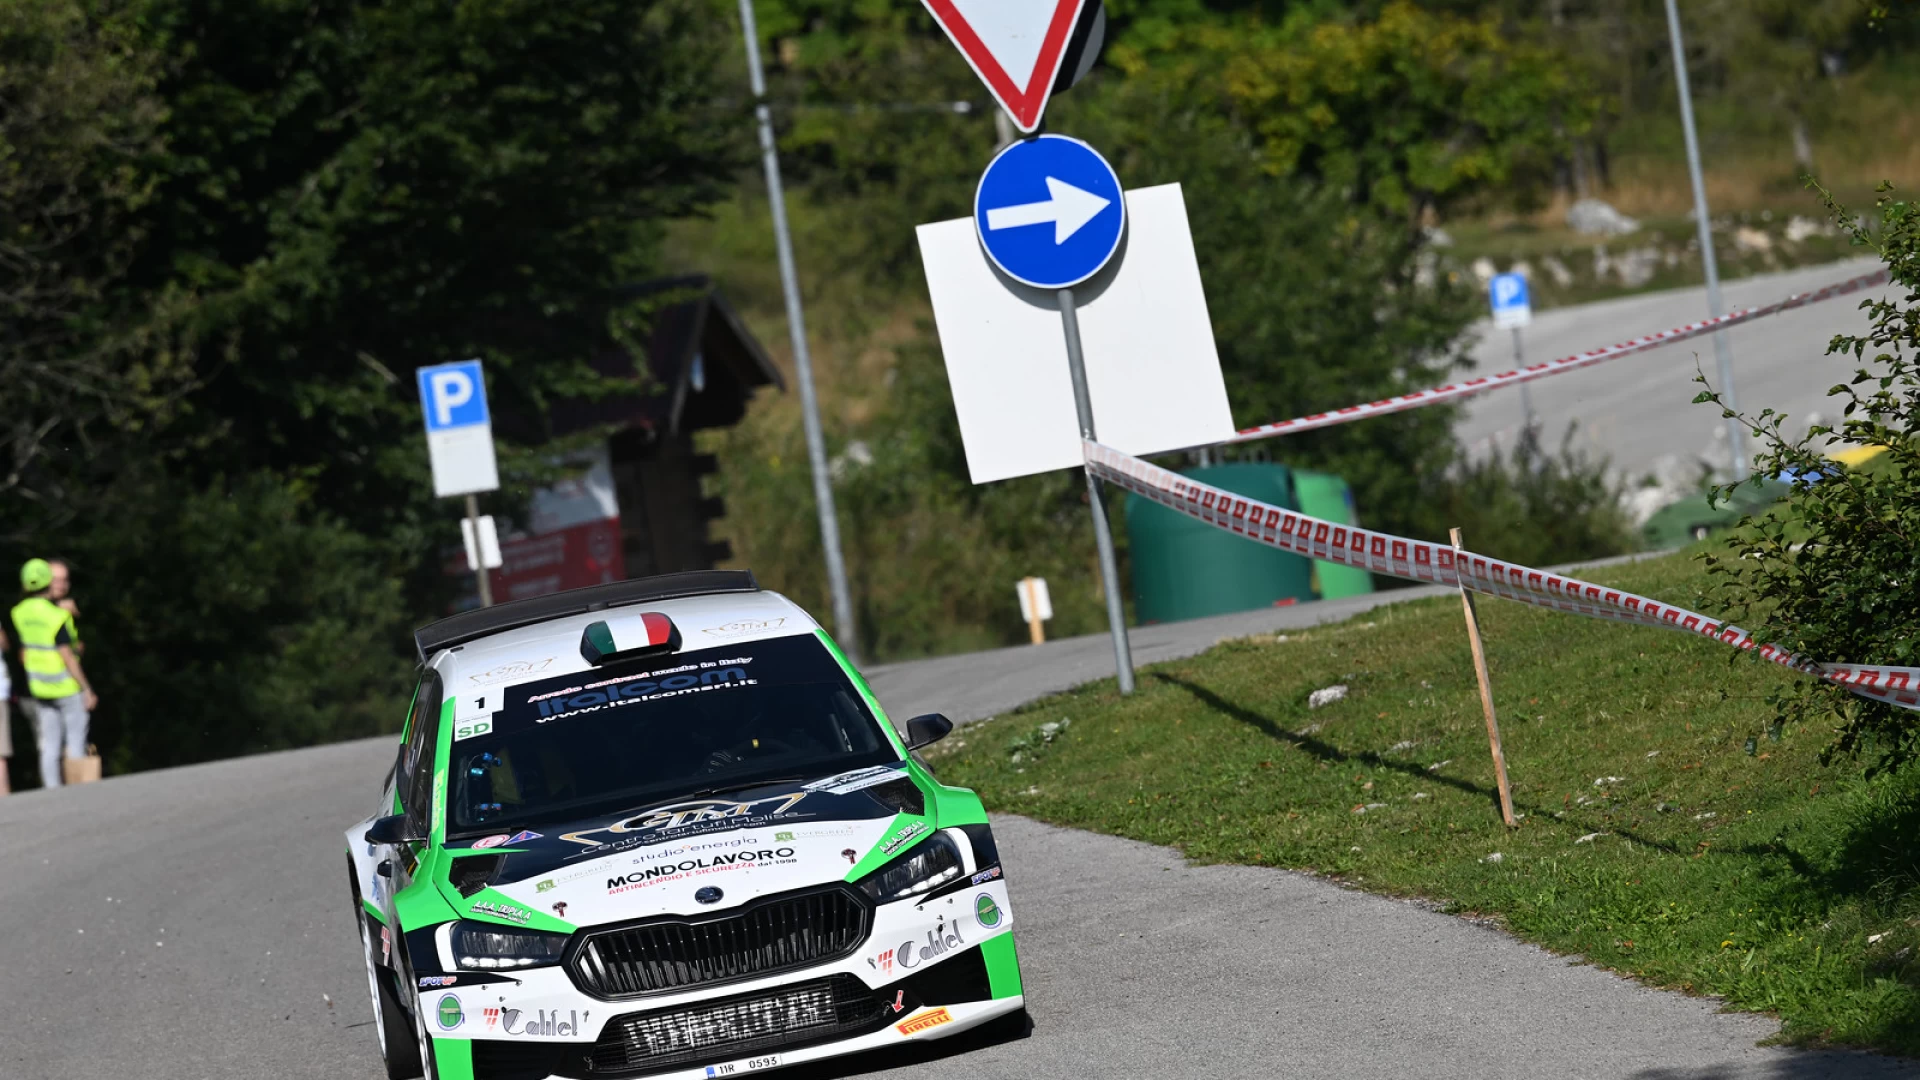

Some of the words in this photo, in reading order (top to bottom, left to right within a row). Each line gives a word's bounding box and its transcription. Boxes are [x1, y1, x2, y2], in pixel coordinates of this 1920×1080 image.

[1496, 277, 1519, 307] P
[431, 371, 473, 425] P
[527, 685, 582, 703] Arredo
[584, 672, 650, 690] contract
[652, 664, 698, 677] made
[700, 661, 716, 669] in
[719, 657, 753, 667] Italy
[474, 697, 485, 709] 1
[457, 723, 490, 738] SD
[731, 811, 799, 824] Molise
[606, 847, 795, 889] MONDOLAVORO
[608, 873, 683, 895] ANTINCENDIO
[695, 861, 756, 876] SICUREZZA
[757, 858, 773, 868] dal
[775, 857, 797, 866] 1998
[896, 1009, 950, 1036] PIRELLI
[719, 1064, 735, 1075] 11R
[749, 1056, 777, 1069] 0593
